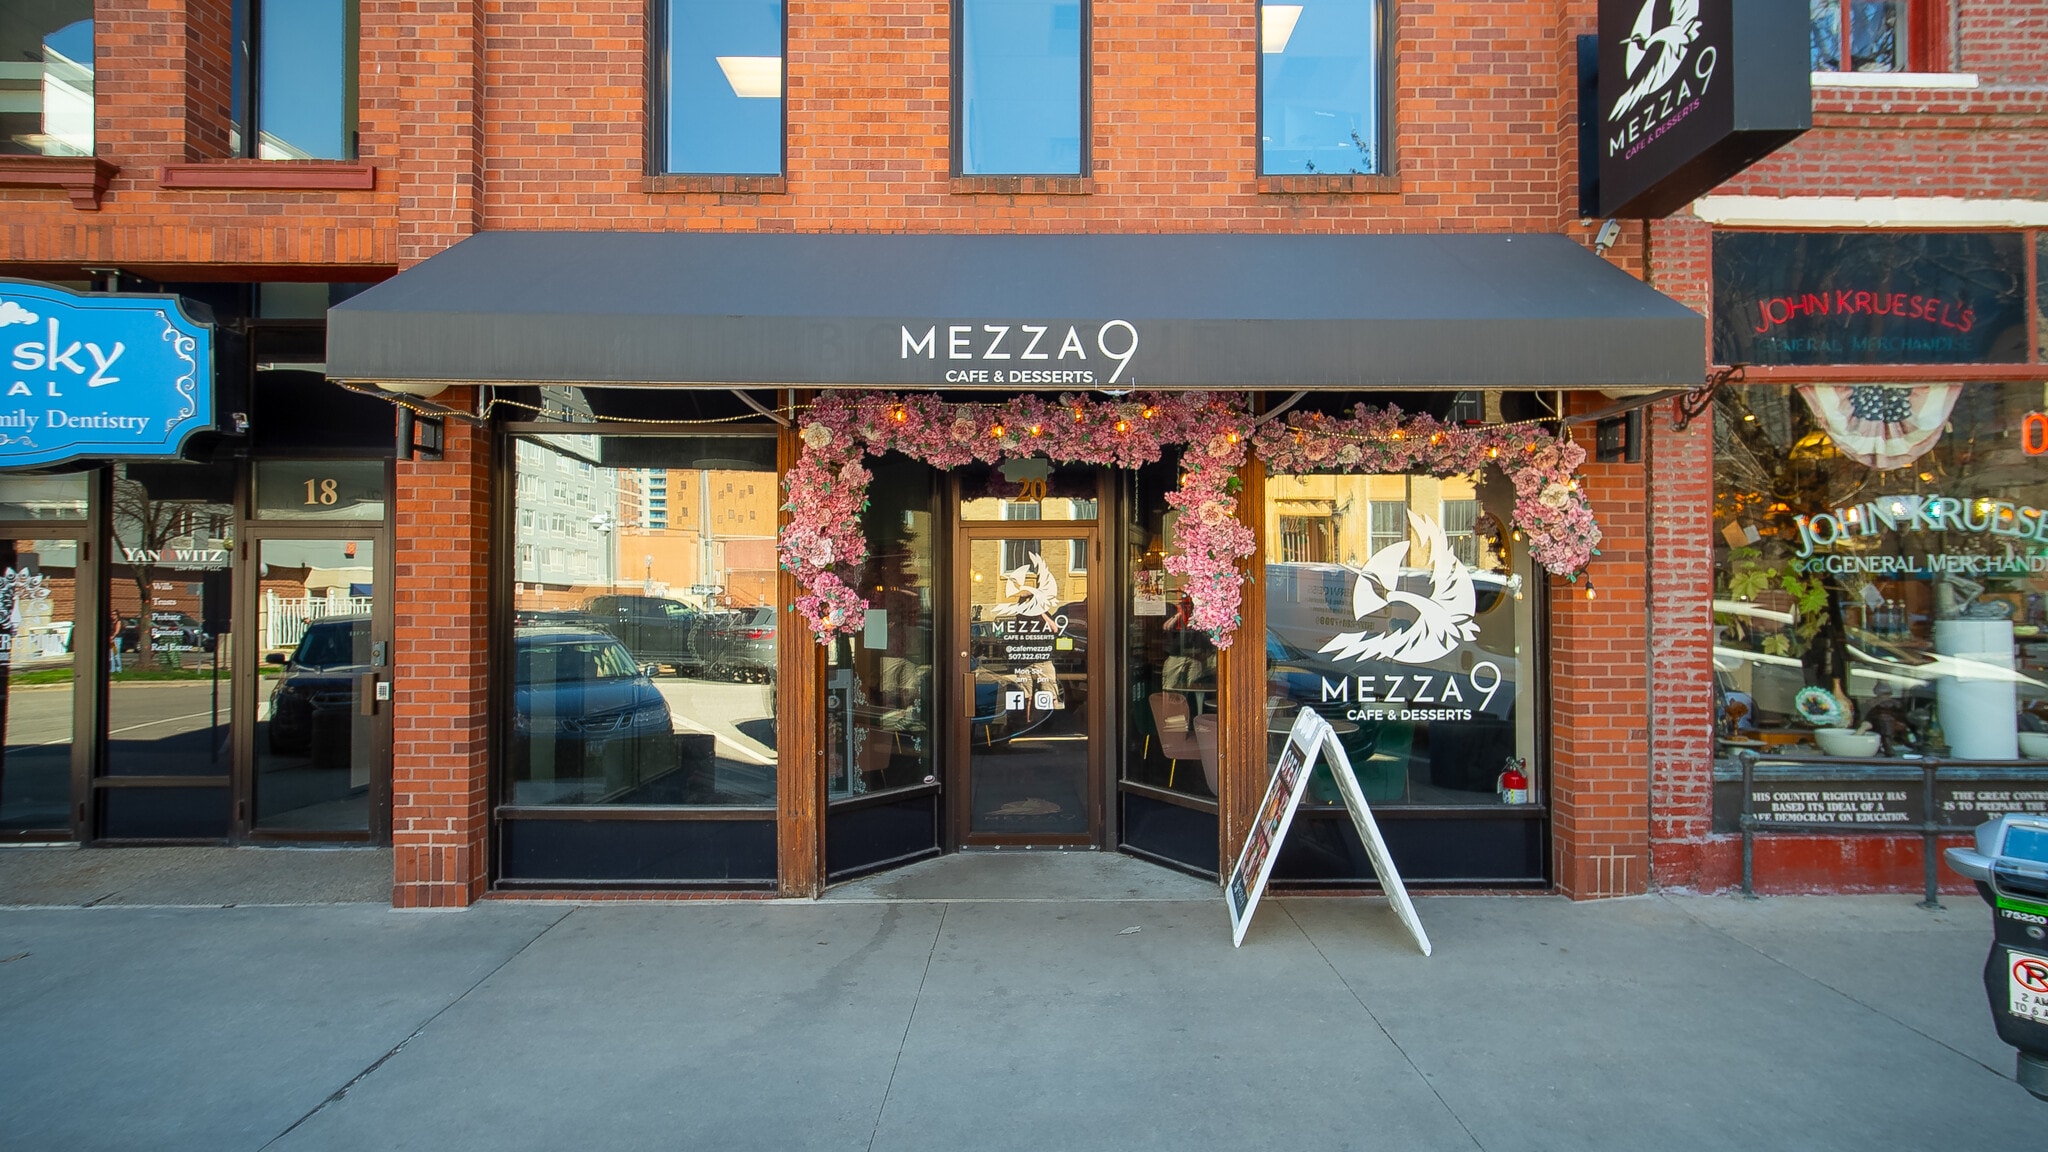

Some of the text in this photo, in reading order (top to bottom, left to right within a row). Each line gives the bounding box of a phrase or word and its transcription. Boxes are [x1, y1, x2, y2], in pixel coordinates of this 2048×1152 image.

[1610, 46, 1717, 157] MEZZA 9
[1625, 97, 1700, 160] CAFE & DESSERTS
[1755, 290, 1974, 333] JOHN KRUESEL'S
[12, 317, 126, 388] sky
[901, 319, 1139, 384] MEZZA 9
[945, 370, 1093, 383] CAFE & DESSERTS
[46, 409, 151, 435] Dentistry
[303, 478, 338, 505] 18
[1015, 476, 1047, 503] 20
[1793, 502, 1897, 559] JOHN
[122, 547, 223, 562] YANOWITZ
[1826, 555, 1923, 573] GENERAL
[992, 614, 1069, 637] MEZZA 9
[1006, 645, 1053, 653] @cafemezza9
[1322, 661, 1502, 711] MEZZA 9
[1347, 709, 1472, 721] CAFE & DESSERTS
[1752, 792, 1907, 801] HIS COUNTRY RIGHTFULLY HAS
[1952, 791, 1975, 800] THE
[1977, 791, 2011, 800] GREAT
[1772, 802, 1885, 812] BASED ITS IDEAL OF A
[1943, 801, 2047, 811] IS TO PREPARE THE
[1774, 812, 1836, 822] DEMOCRACY
[1838, 812, 1853, 822] ON
[2021, 992, 2030, 1003] 2
[2014, 1001, 2028, 1012] TO
[2031, 1006, 2039, 1016] 6
